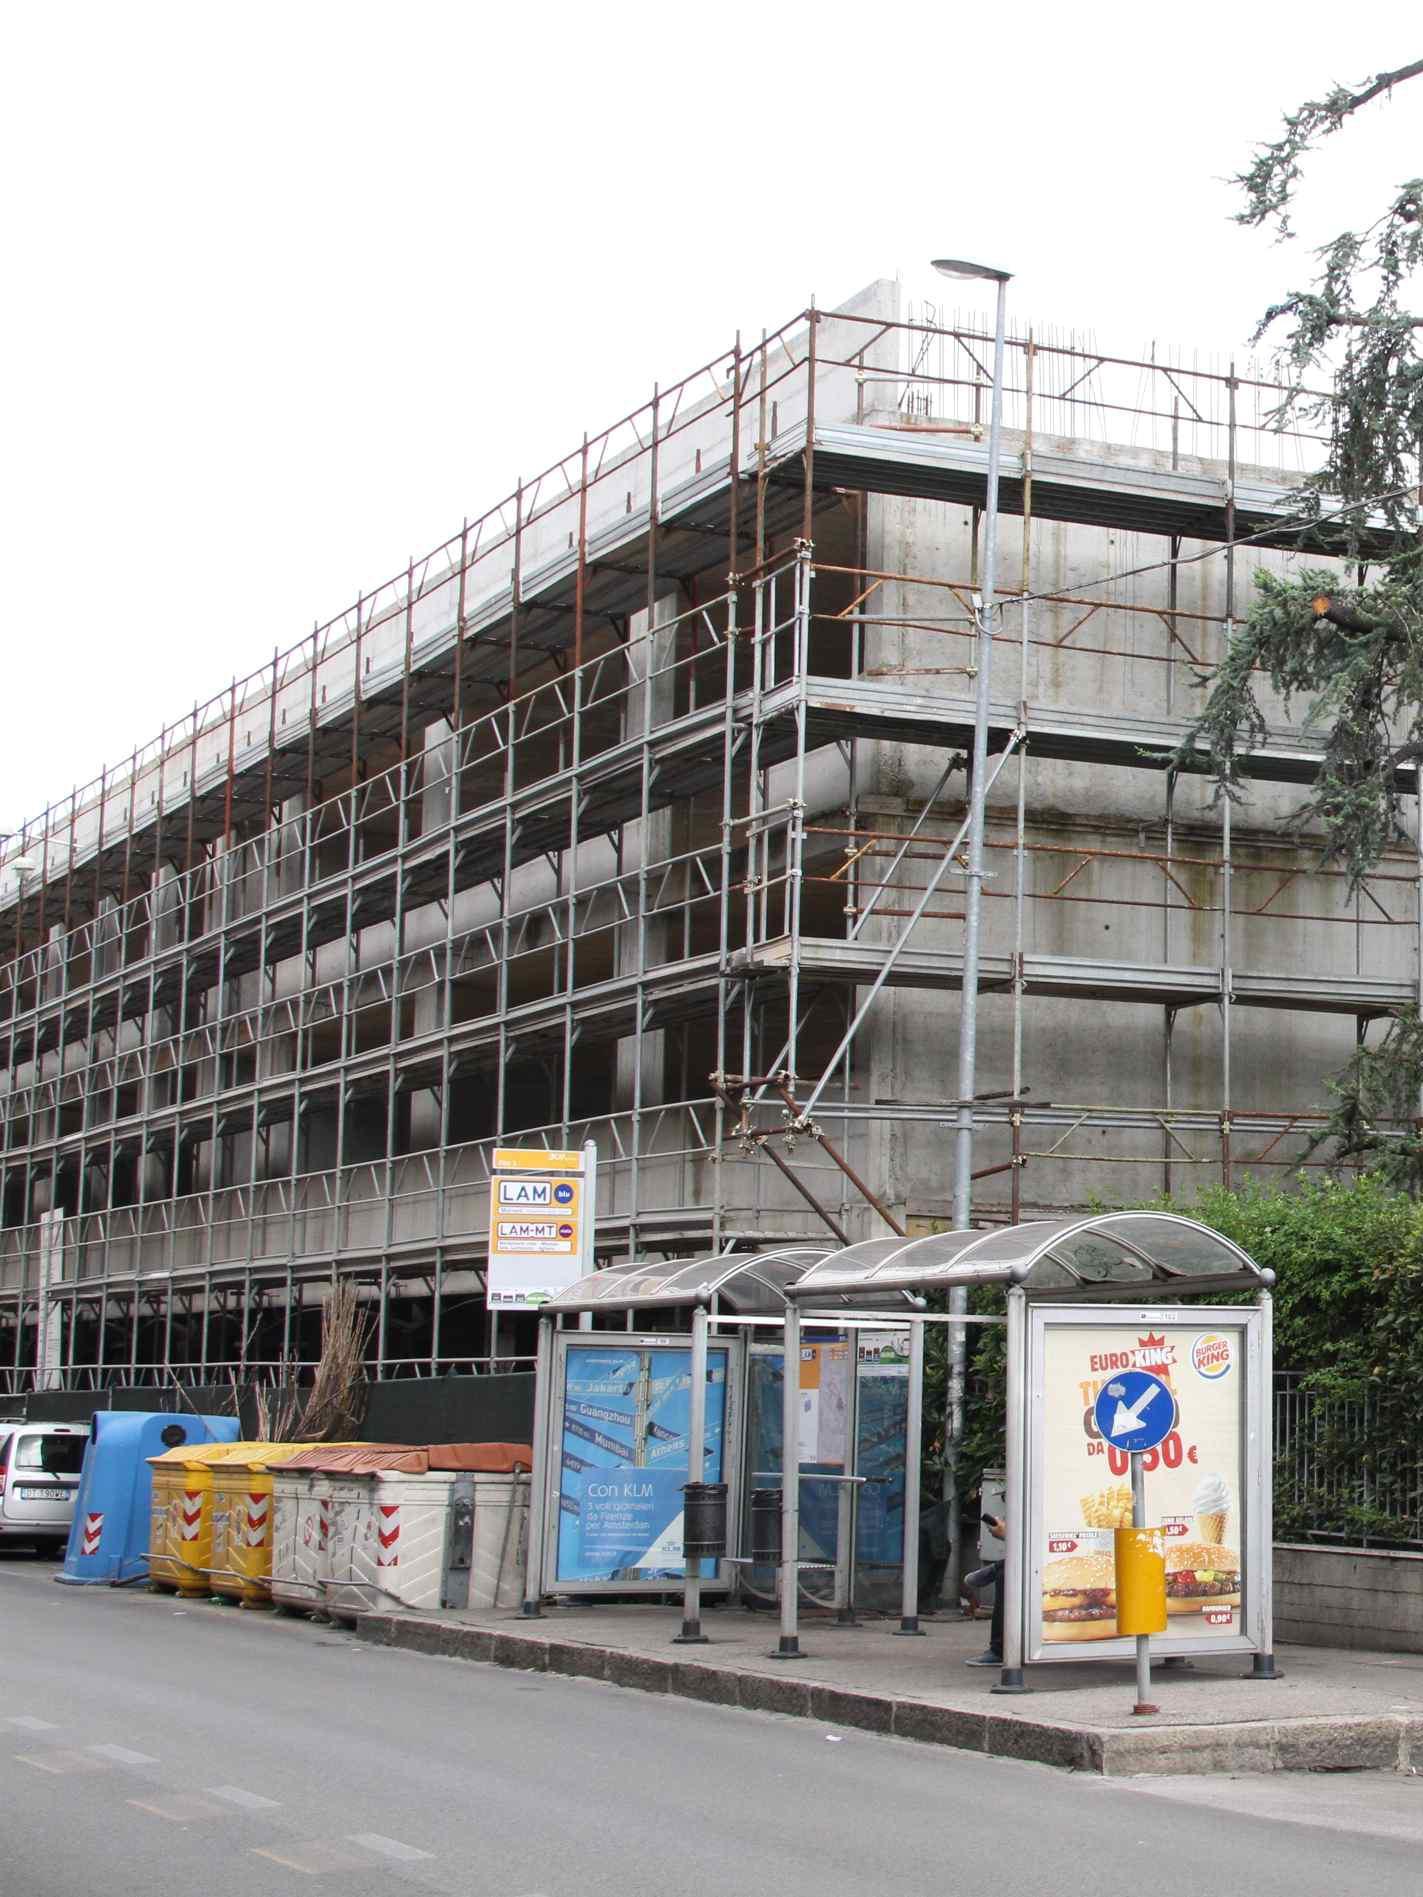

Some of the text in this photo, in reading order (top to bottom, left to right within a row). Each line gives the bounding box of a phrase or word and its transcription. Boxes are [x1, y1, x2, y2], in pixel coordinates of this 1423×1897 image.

[503, 1185, 547, 1201] LAM
[500, 1225, 554, 1236] LAM-MT
[1089, 1346, 1176, 1372] EURO KING
[1195, 1340, 1229, 1359] BURGER
[1196, 1351, 1230, 1370] KING
[580, 1403, 631, 1425] Guangzhou
[595, 1432, 629, 1457] Mumbai
[1087, 1441, 1105, 1456] DA
[587, 1483, 654, 1497] Con KLM
